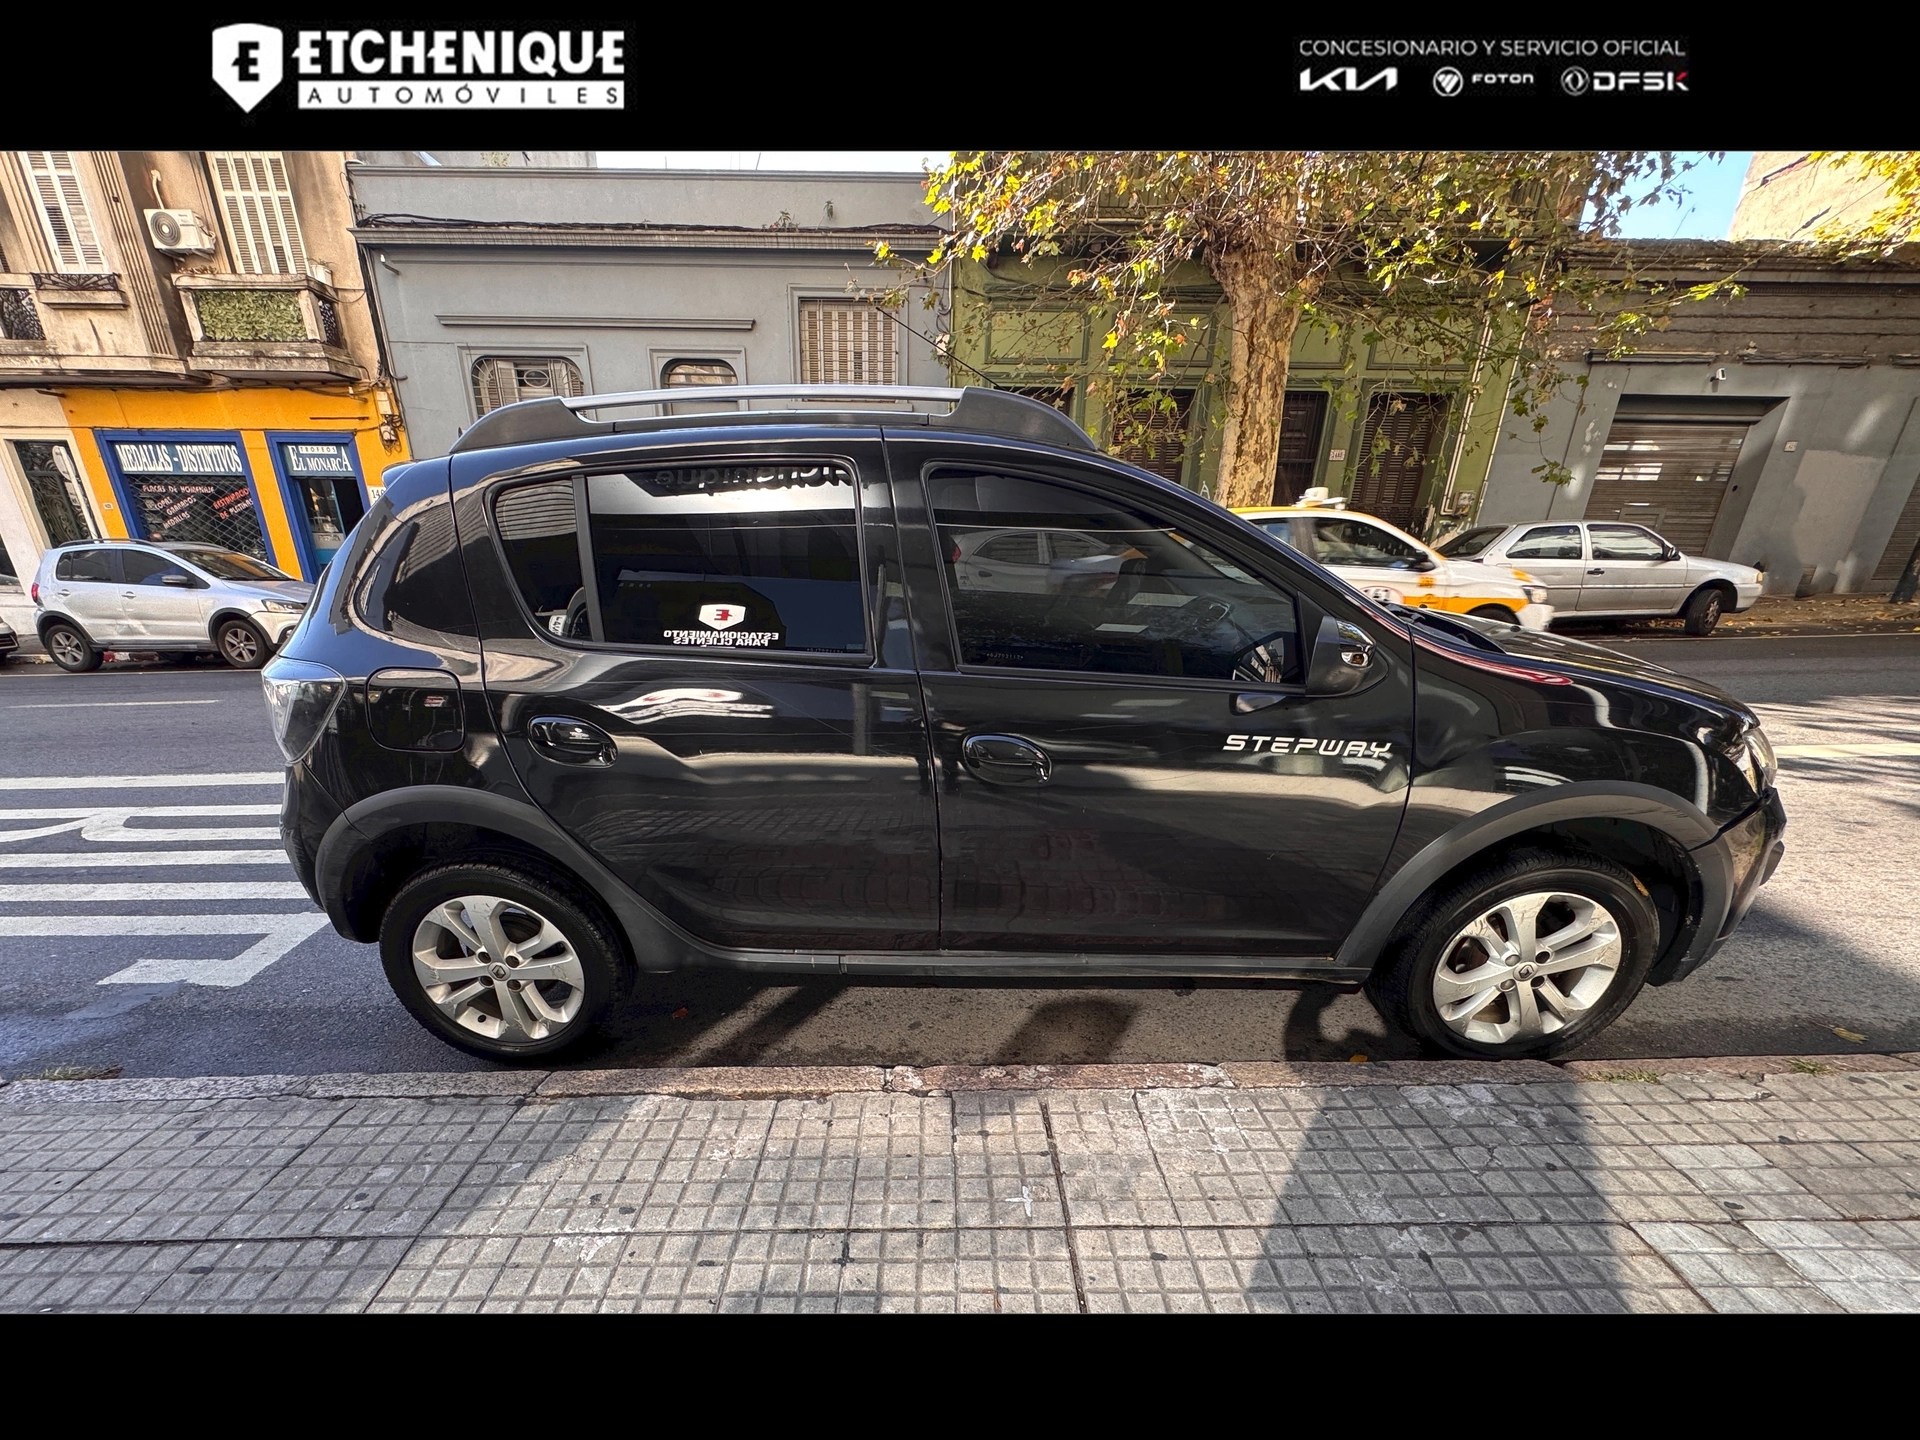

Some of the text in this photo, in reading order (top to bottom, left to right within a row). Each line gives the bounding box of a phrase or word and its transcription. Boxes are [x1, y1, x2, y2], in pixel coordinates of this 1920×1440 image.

[115, 444, 174, 472] MEDALLAS
[175, 444, 243, 473] DISTINTIVOS
[287, 445, 353, 471] EL MONARCA
[1222, 734, 1392, 758] STEPWAY
